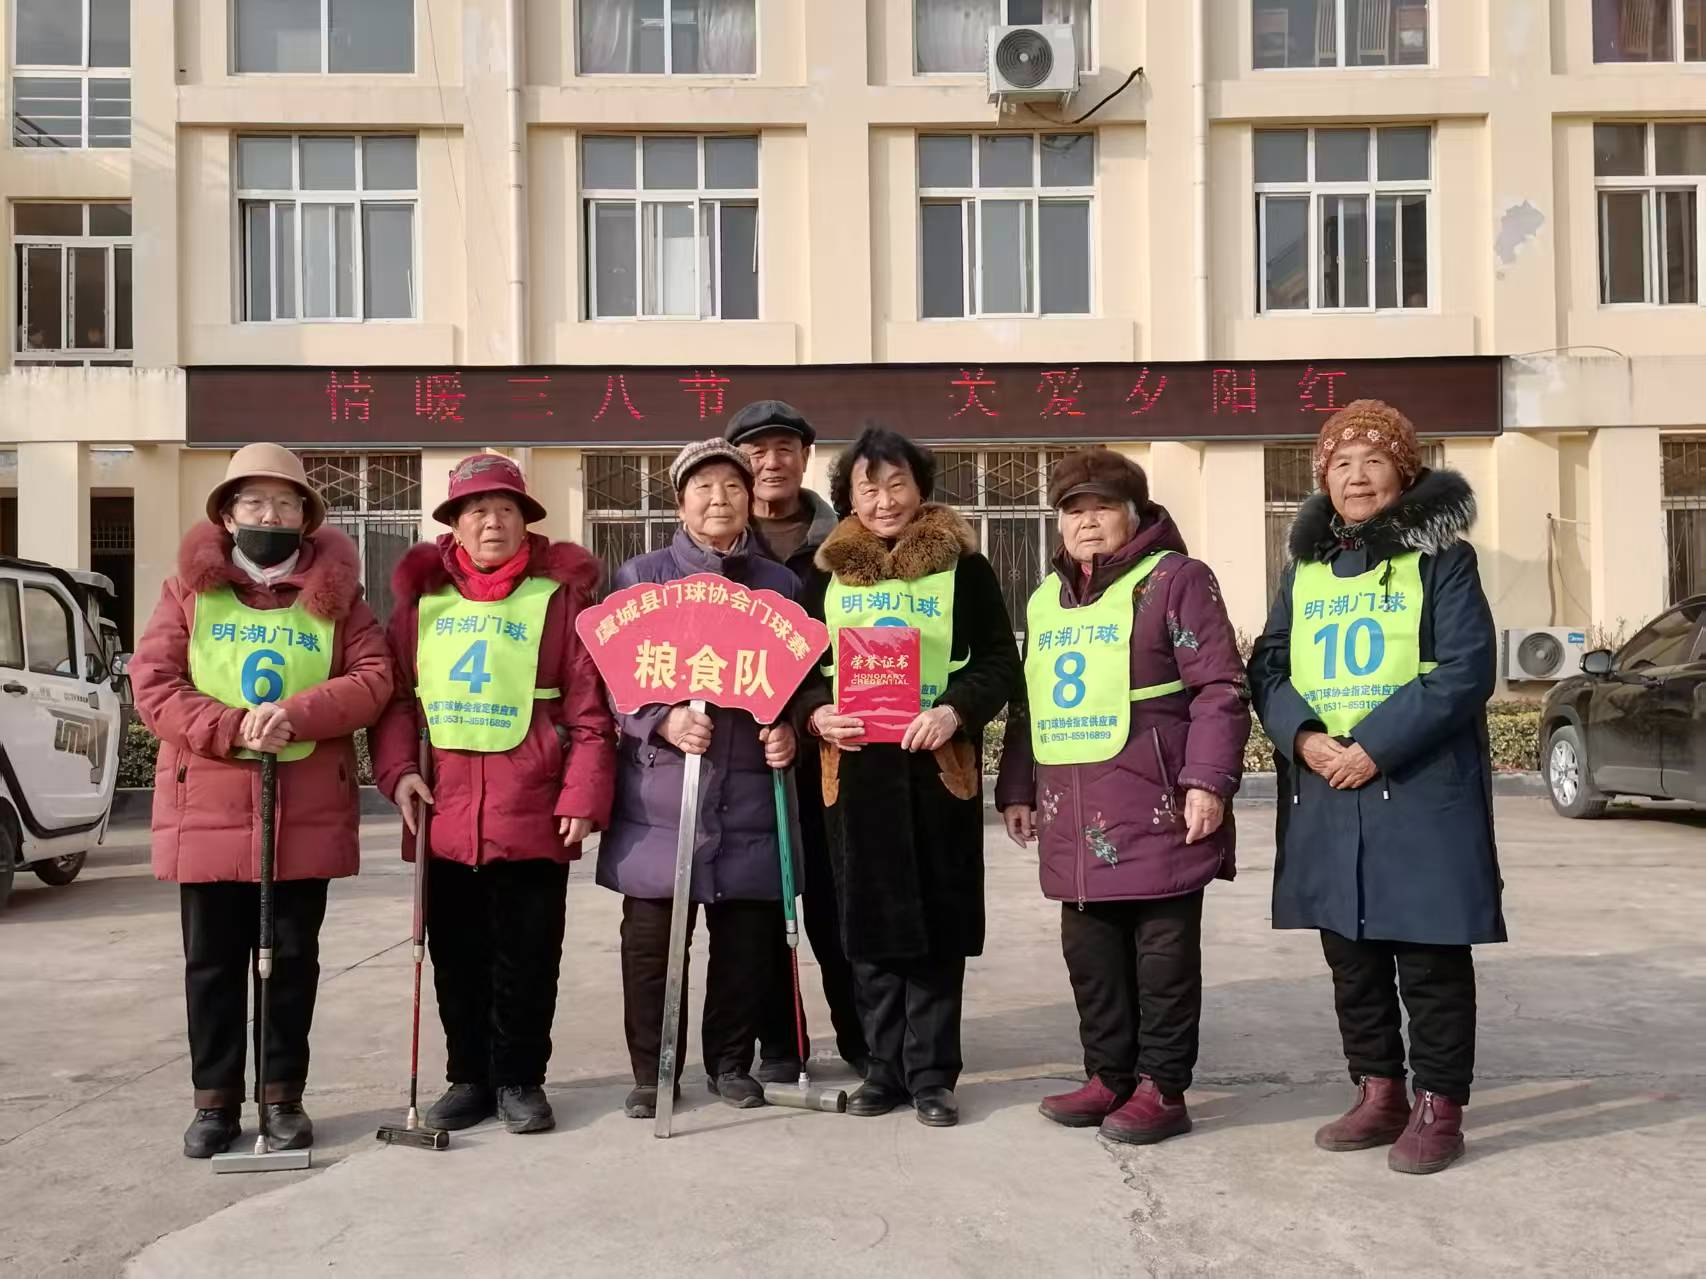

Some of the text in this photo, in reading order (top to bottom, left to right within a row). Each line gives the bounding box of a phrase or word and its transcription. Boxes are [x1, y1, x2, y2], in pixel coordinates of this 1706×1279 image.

[325, 365, 1348, 423] 情暖三八节 关爱夕阳红
[841, 592, 942, 618] 明湖门球
[1303, 591, 1408, 620] 明湖门球
[211, 623, 321, 653] 明湖门球
[435, 614, 528, 642] 明湖门球
[1038, 623, 1120, 652] 明湖门球
[1313, 617, 1385, 680] 10
[241, 648, 286, 705] 6
[449, 639, 492, 694] 4
[633, 639, 776, 699] 粮食队
[850, 654, 909, 671] 荣誉证书
[1052, 651, 1087, 709] 8
